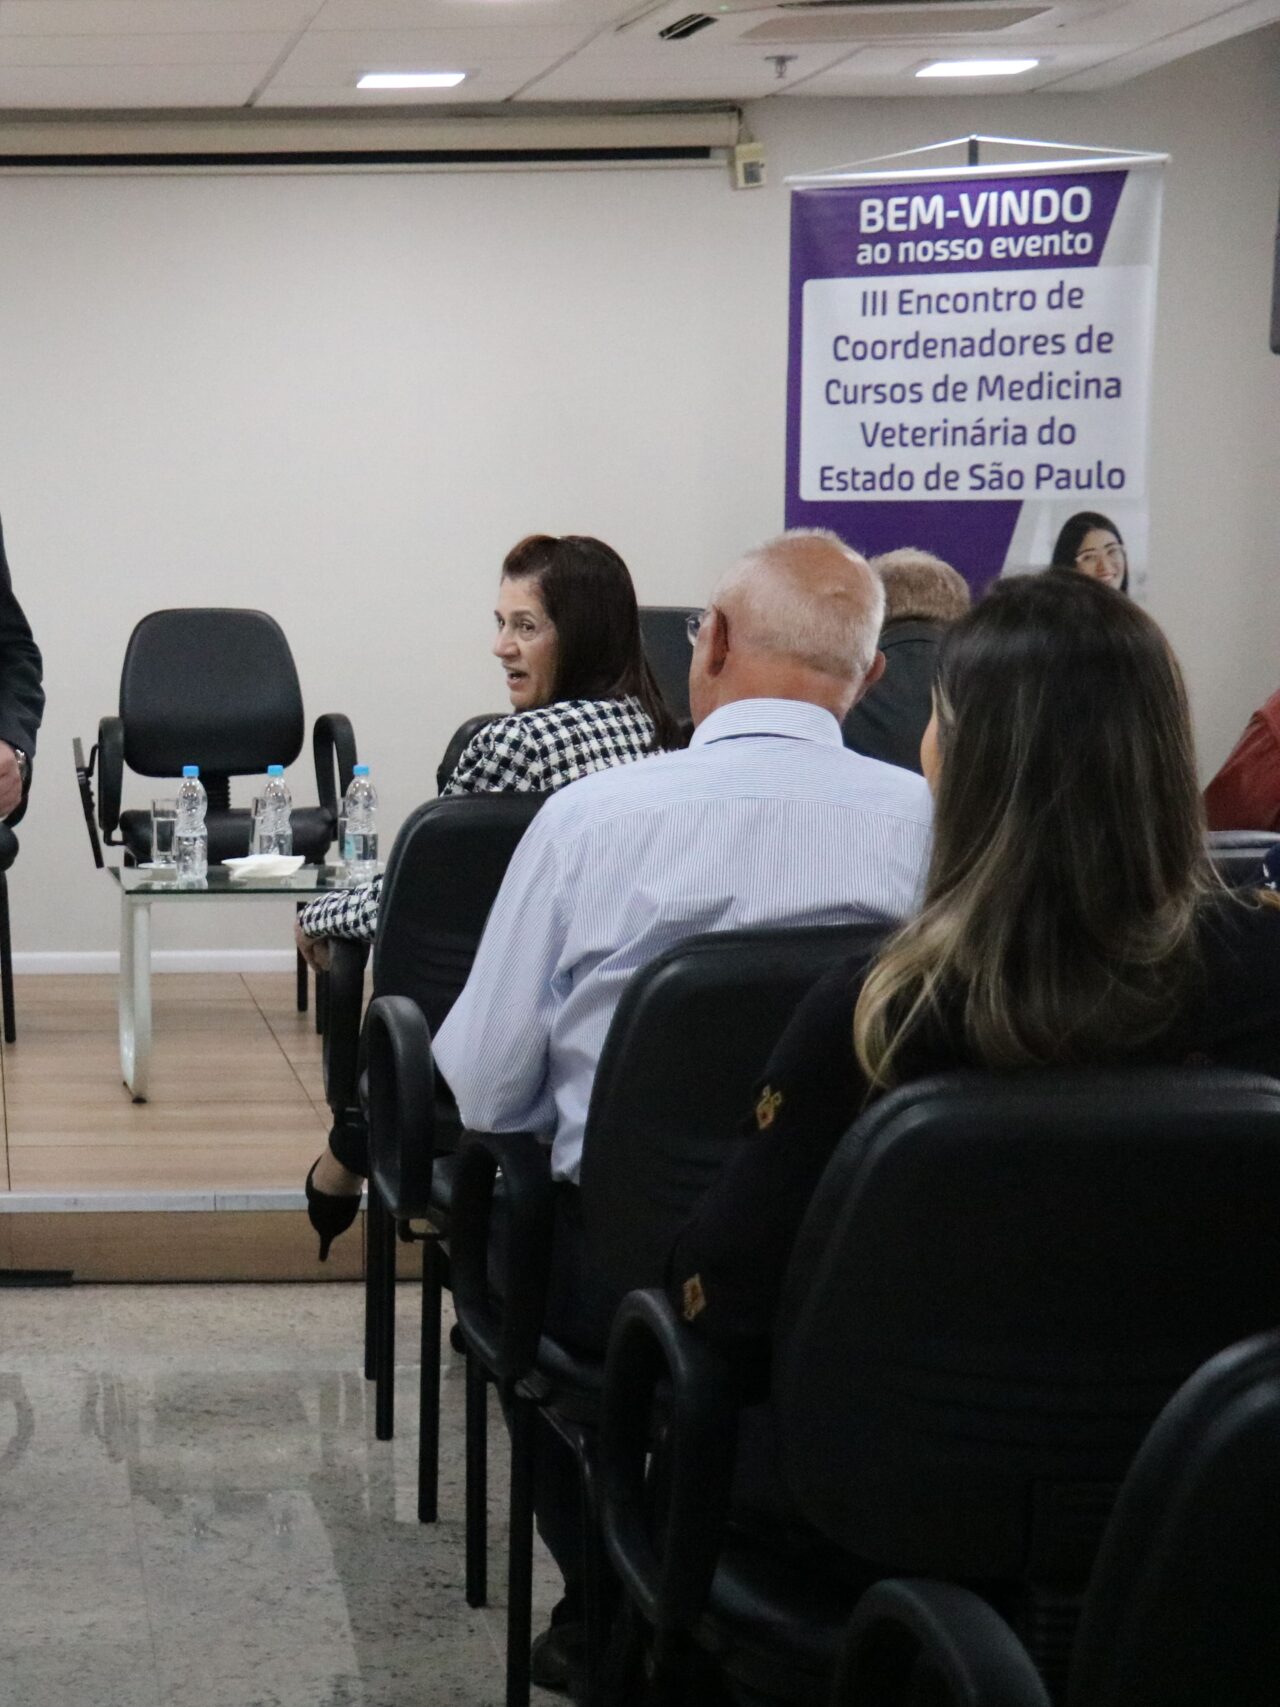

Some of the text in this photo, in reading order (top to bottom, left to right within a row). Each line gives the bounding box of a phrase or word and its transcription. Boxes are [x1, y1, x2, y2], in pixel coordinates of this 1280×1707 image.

[859, 185, 1092, 233] BEM-VINDO
[856, 230, 1093, 265] ao nosso evento
[861, 281, 1084, 317] III Encontro de
[832, 325, 1114, 362] Coordenadores de
[825, 372, 1122, 406] Cursos de Medicina
[860, 417, 1076, 448] Veterinária do
[819, 461, 1126, 492] Estado de São Paulo
